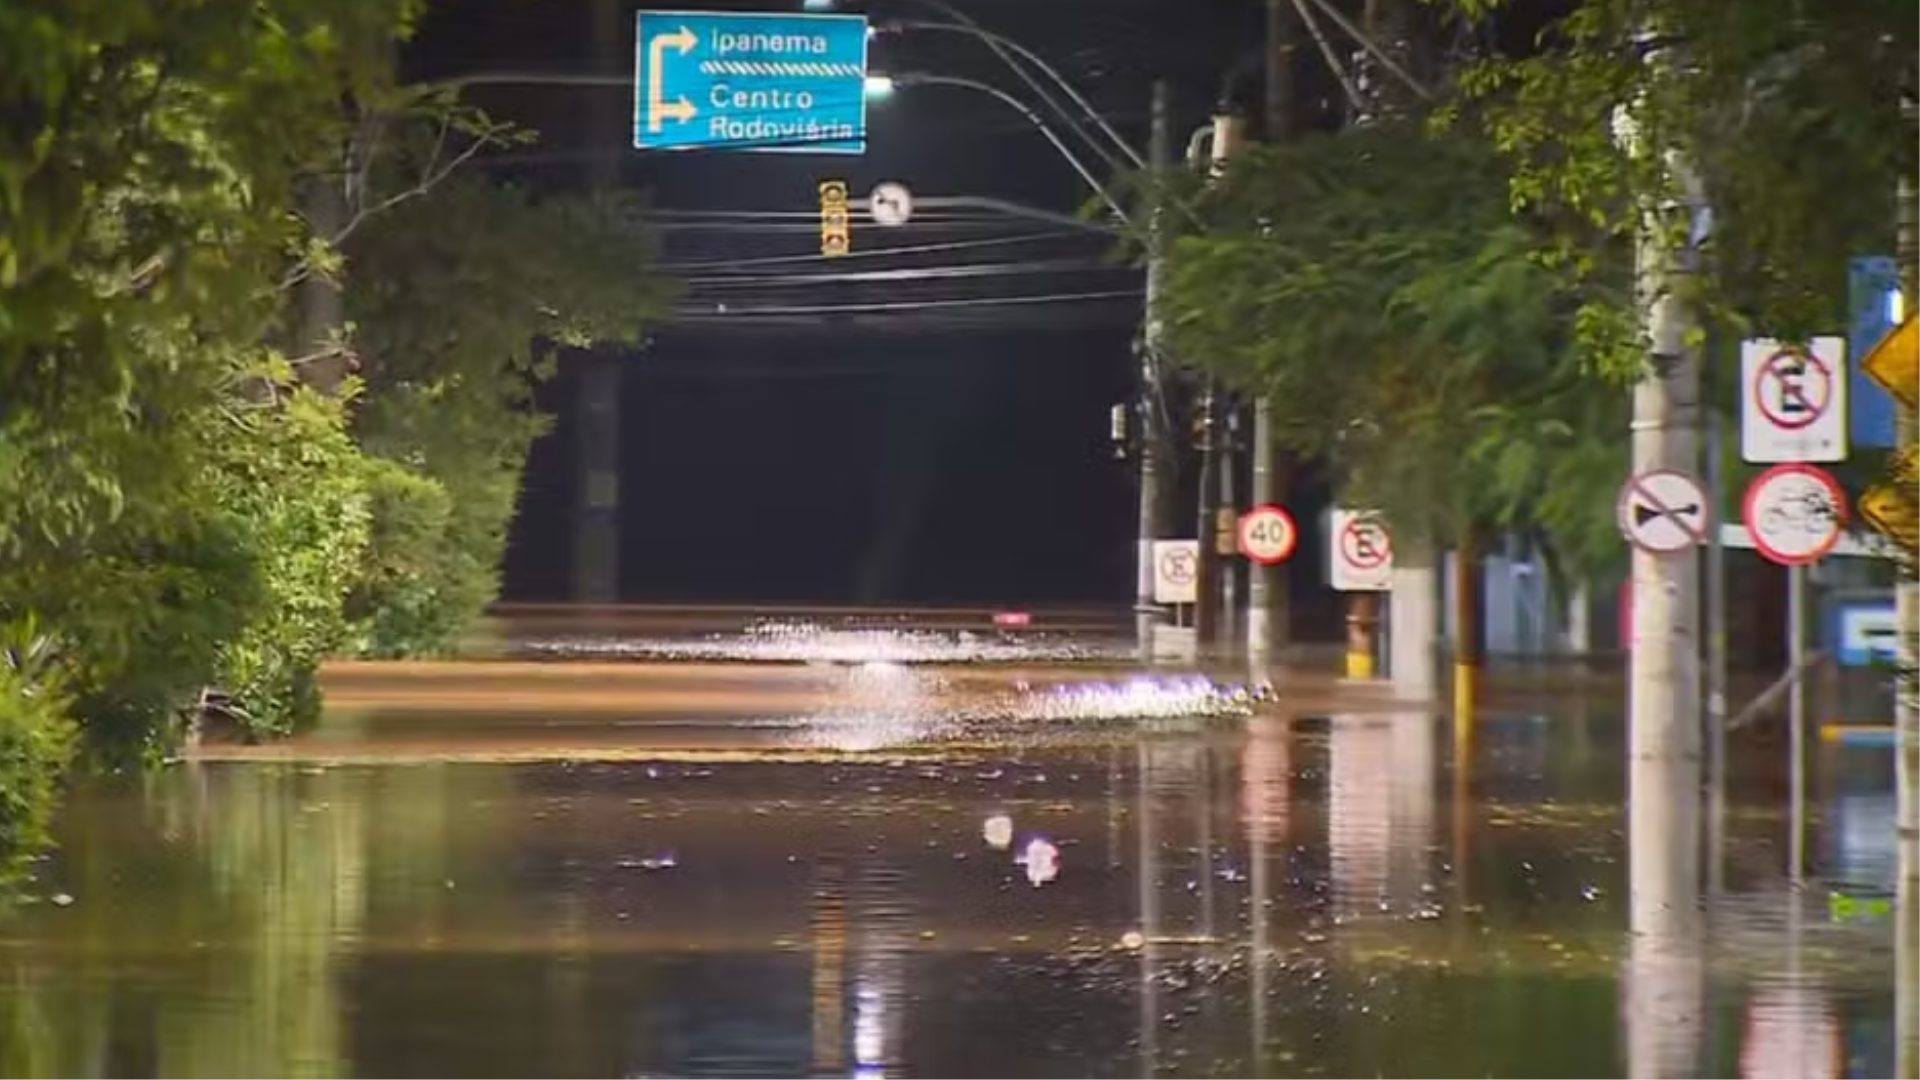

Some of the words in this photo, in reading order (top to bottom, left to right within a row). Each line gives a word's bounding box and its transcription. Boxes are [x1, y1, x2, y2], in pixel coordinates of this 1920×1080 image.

[711, 28, 827, 55] Ipanema
[710, 84, 813, 108] Centro
[1250, 519, 1283, 544] 40
